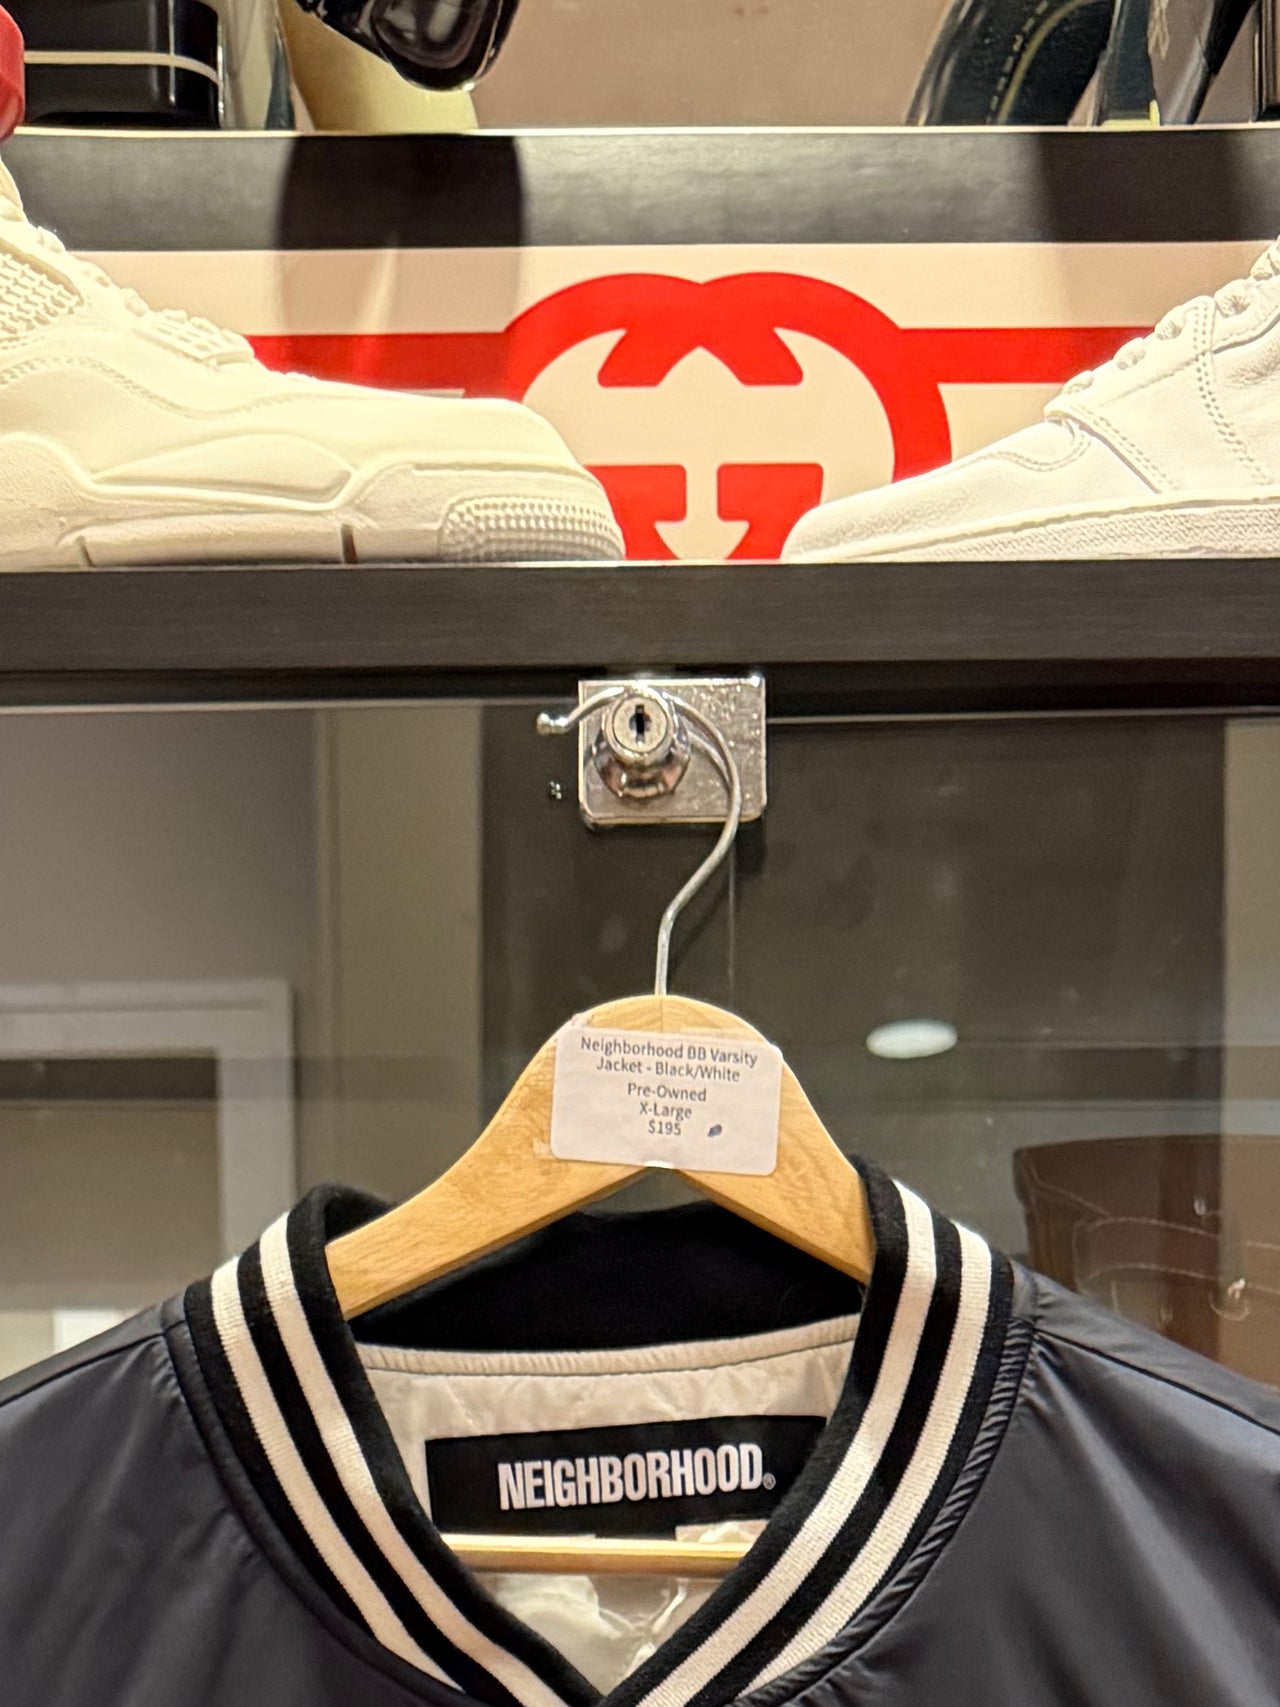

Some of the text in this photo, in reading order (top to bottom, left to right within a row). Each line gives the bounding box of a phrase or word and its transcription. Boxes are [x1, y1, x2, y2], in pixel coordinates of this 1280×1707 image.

[580, 1036, 758, 1069] Neighborhood BB Varsity
[596, 1057, 642, 1074] Jacket
[655, 1063, 741, 1083] Black/White
[627, 1082, 707, 1102] Pre-Owned
[639, 1102, 693, 1122] X-Large
[648, 1120, 682, 1137] $195
